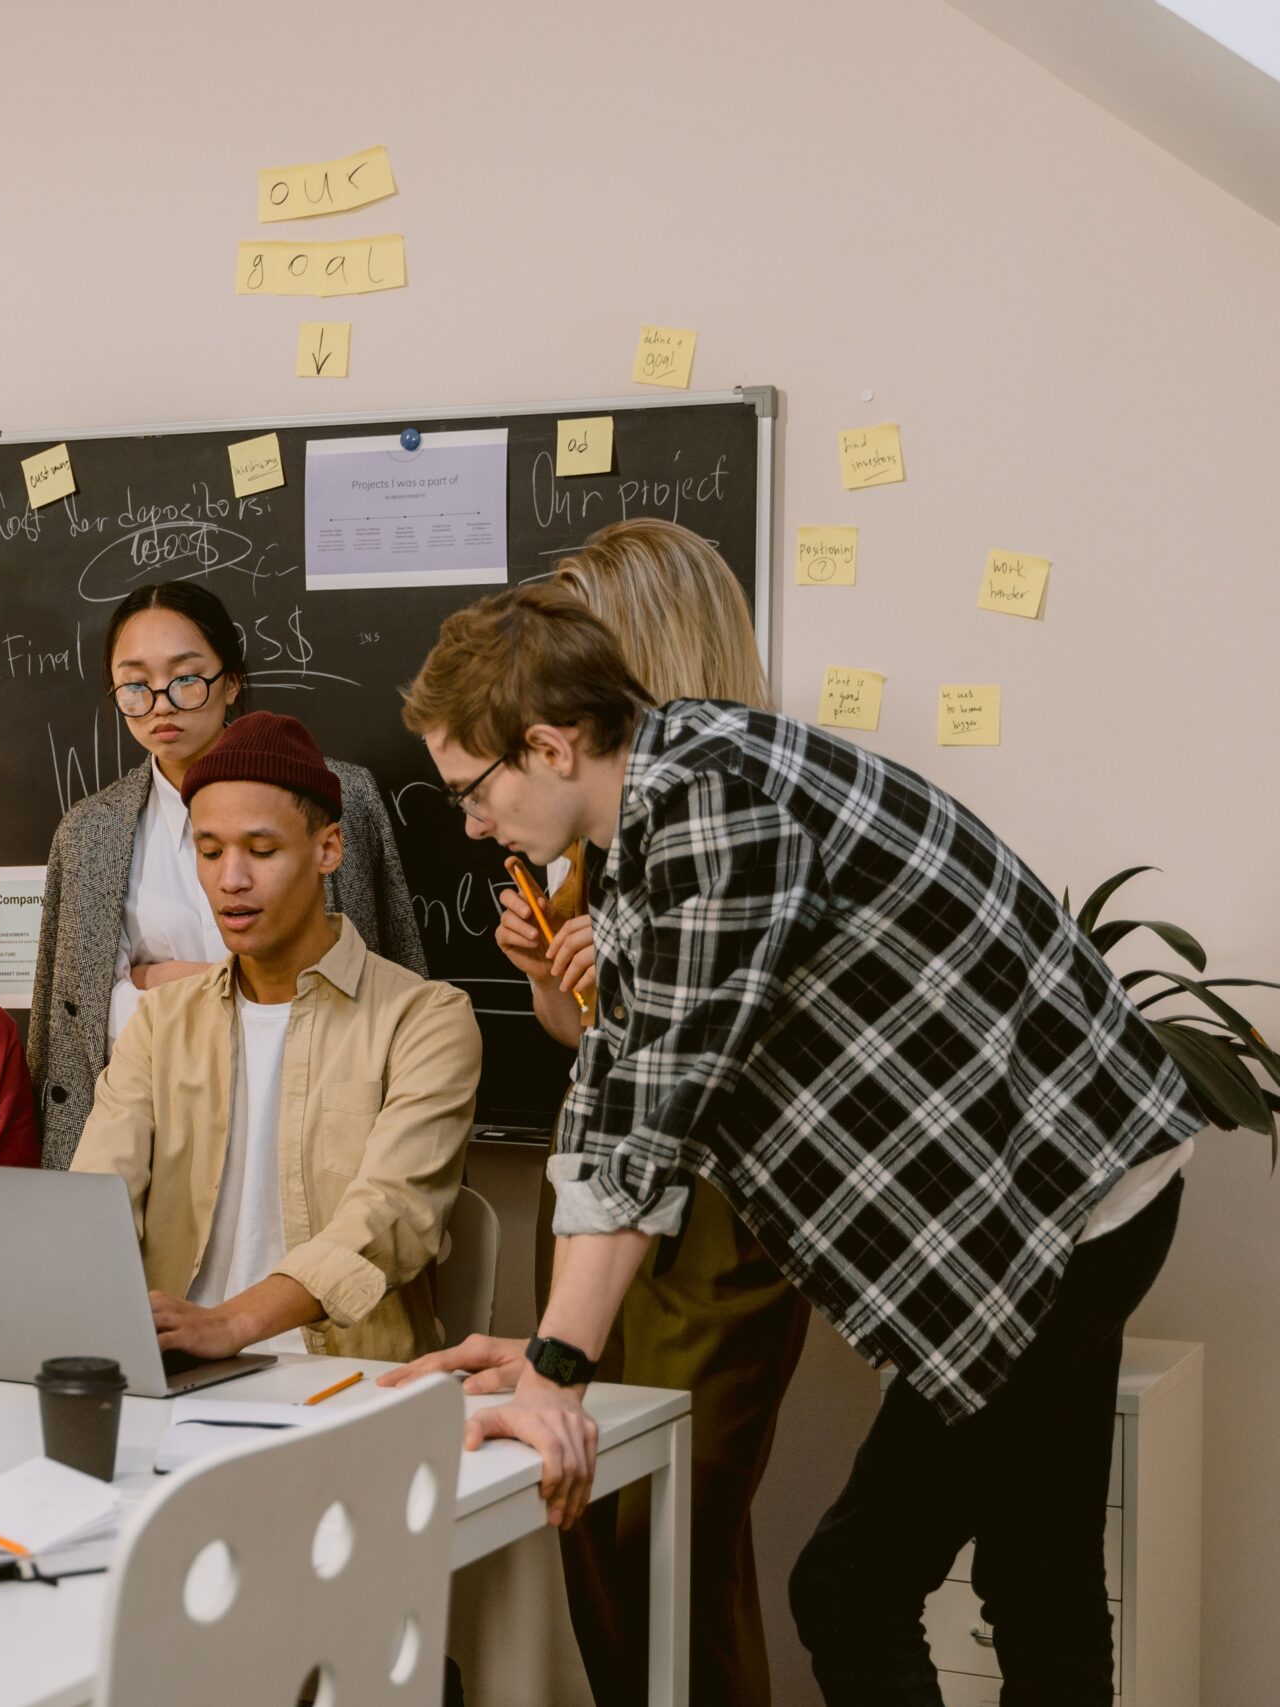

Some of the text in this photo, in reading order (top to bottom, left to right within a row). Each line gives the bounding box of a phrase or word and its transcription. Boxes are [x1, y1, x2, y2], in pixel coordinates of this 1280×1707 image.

[270, 161, 369, 206] our
[246, 244, 384, 290] goal
[642, 350, 676, 377] goal
[567, 430, 589, 454] ad
[850, 448, 897, 473] investors
[351, 474, 459, 493] Projects I was a part of
[532, 449, 730, 528] Our project
[799, 541, 854, 565] positioning
[992, 558, 1028, 580] work
[989, 578, 1030, 601] harder
[2, 620, 85, 680] Final
